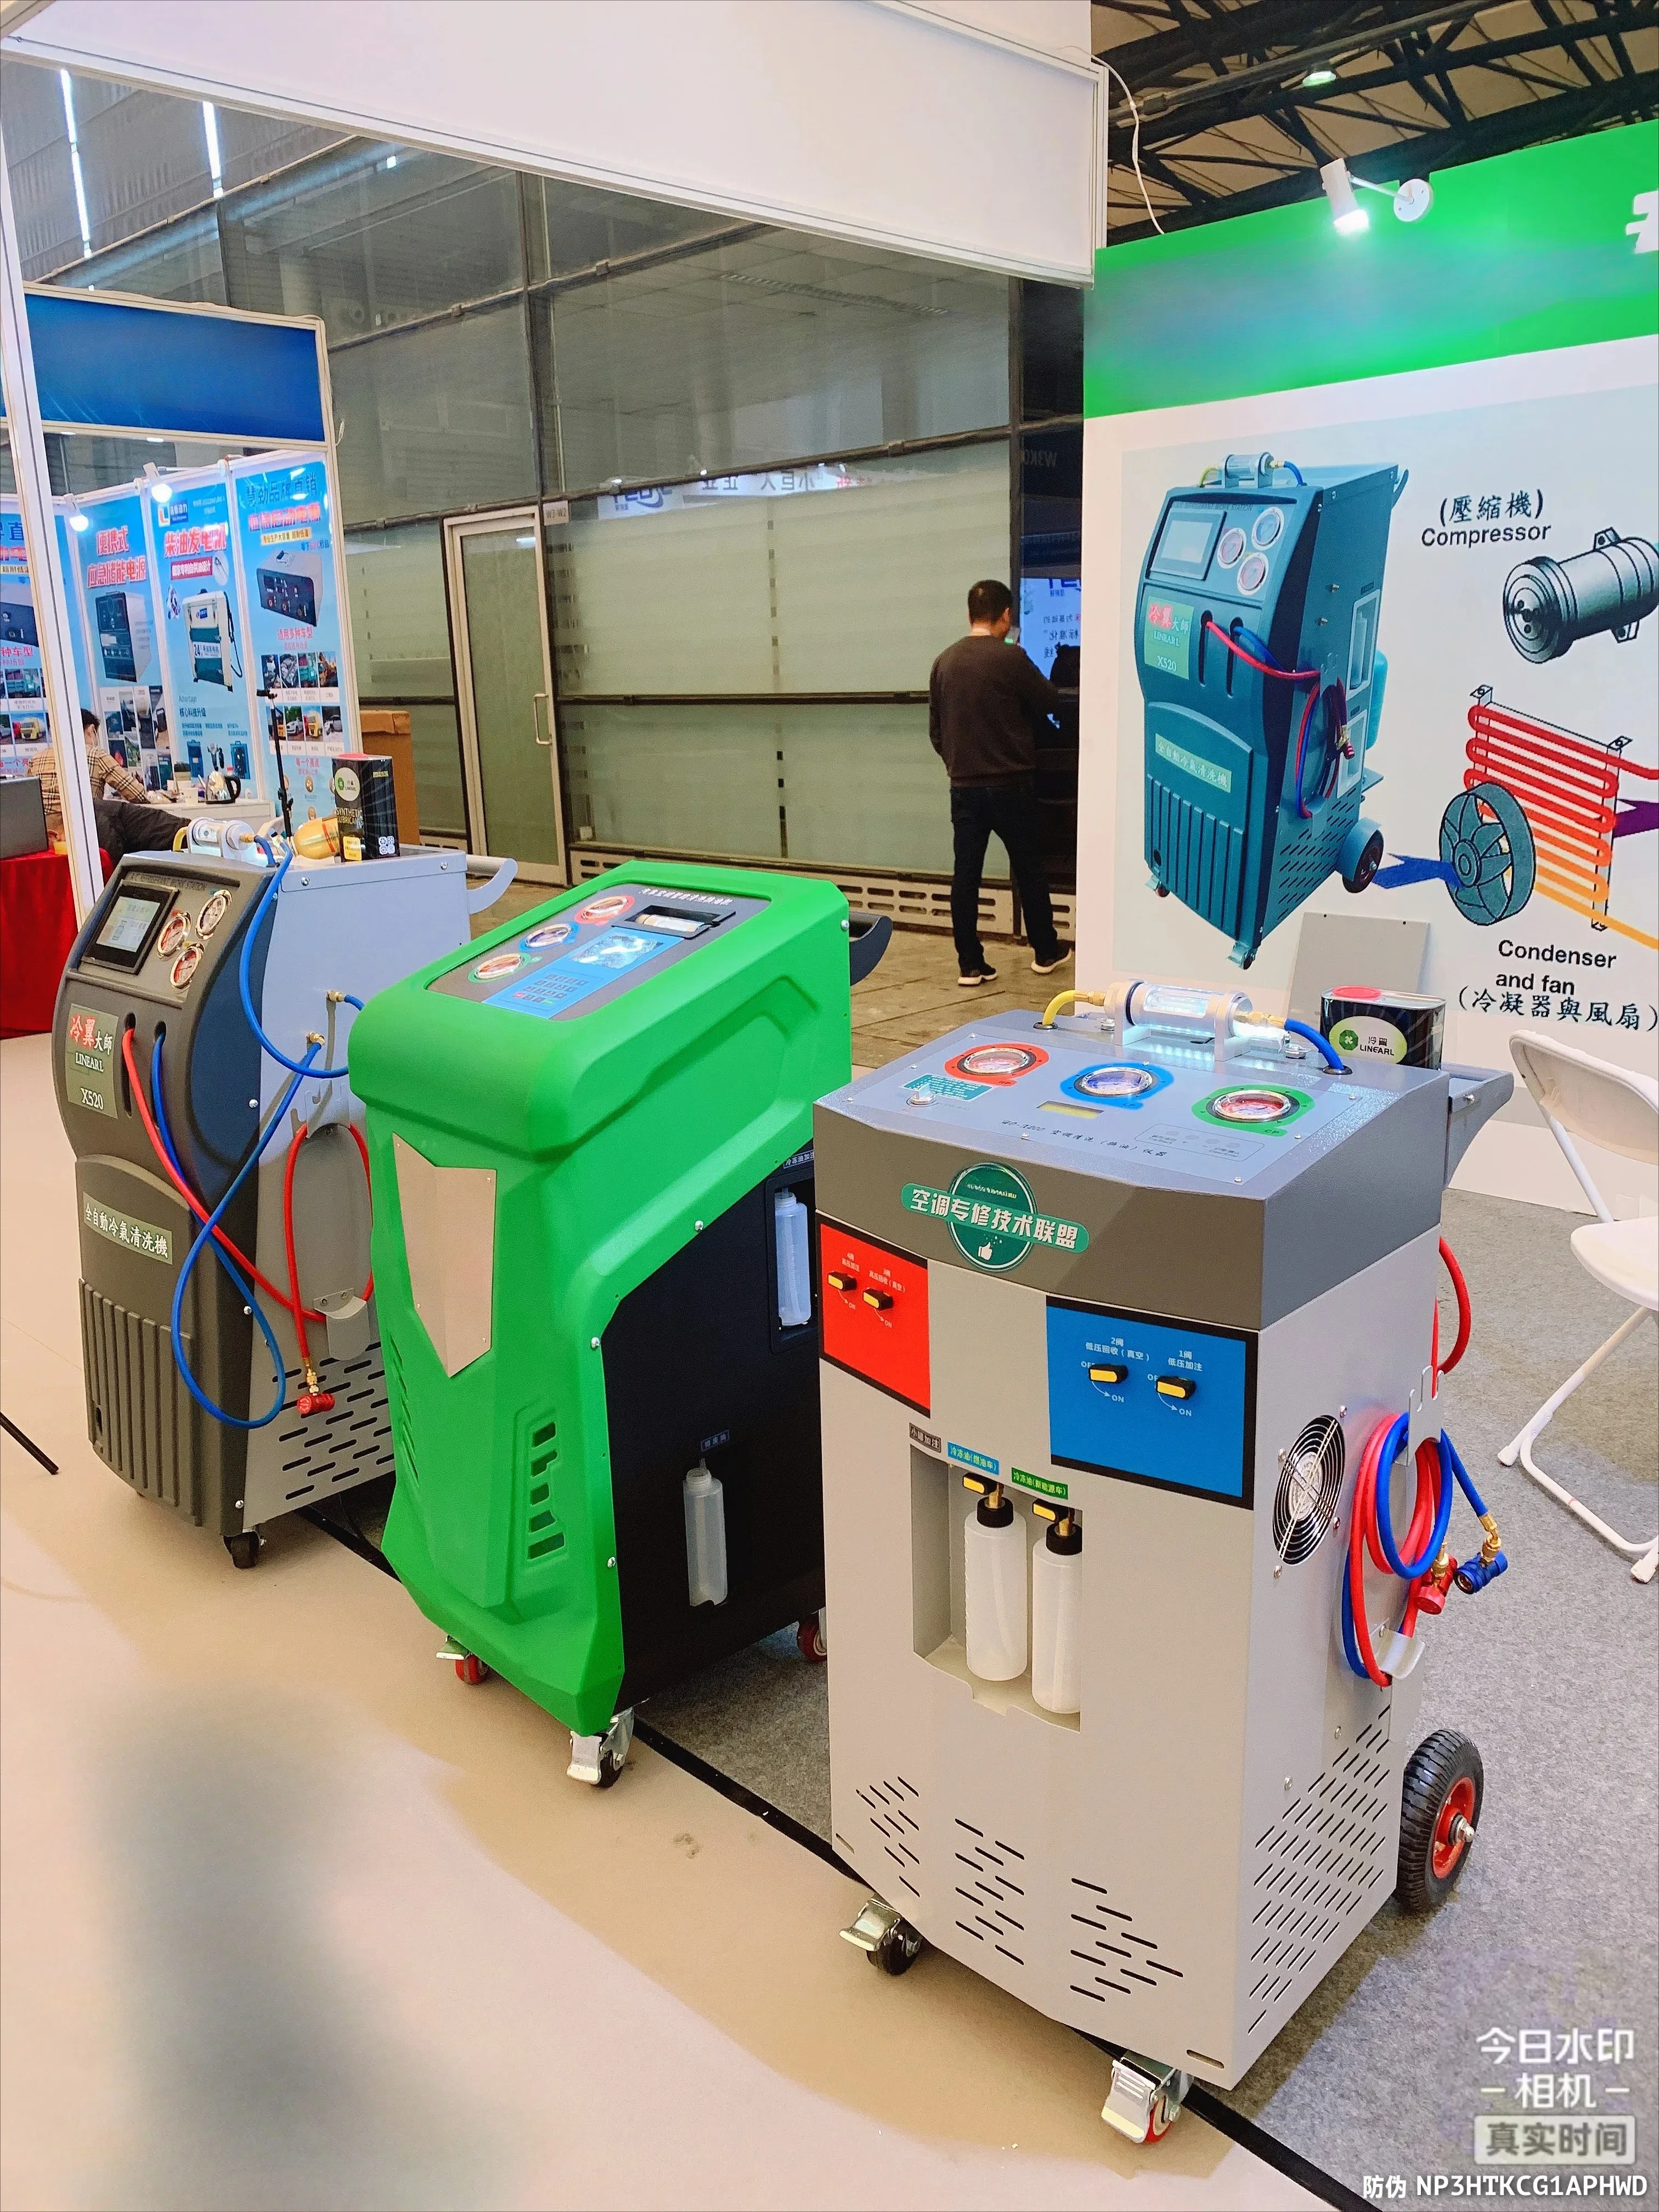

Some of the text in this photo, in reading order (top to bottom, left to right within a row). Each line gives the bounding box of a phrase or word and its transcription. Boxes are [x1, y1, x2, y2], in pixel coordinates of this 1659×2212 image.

[1440, 489, 1543, 527] (壓縮機)
[96, 525, 129, 557] 便携式
[165, 523, 227, 558] 柴油发电机
[1421, 525, 1551, 549] Compressor
[87, 555, 146, 589] 应急储能电源
[1157, 655, 1177, 672] X520
[336, 807, 363, 817] SYNTHETIC
[1498, 940, 1617, 968] Condenser
[1496, 974, 1575, 995] and fan
[70, 1014, 113, 1056] 冷翼大師
[1359, 1044, 1395, 1056] LINEARL
[75, 1052, 104, 1072] LINEARL
[81, 1087, 103, 1110] X520
[910, 1188, 1079, 1250] 空调专修技术联盟
[86, 1202, 168, 1259] 全自動冷氣清洗機
[848, 1302, 856, 1310] ON
[884, 1319, 892, 1328] ON
[1085, 1341, 1150, 1362] 低压回收（真空）
[1167, 1357, 1203, 1372] 低压加注
[1111, 1395, 1125, 1403] ON
[1179, 1408, 1192, 1417] ON
